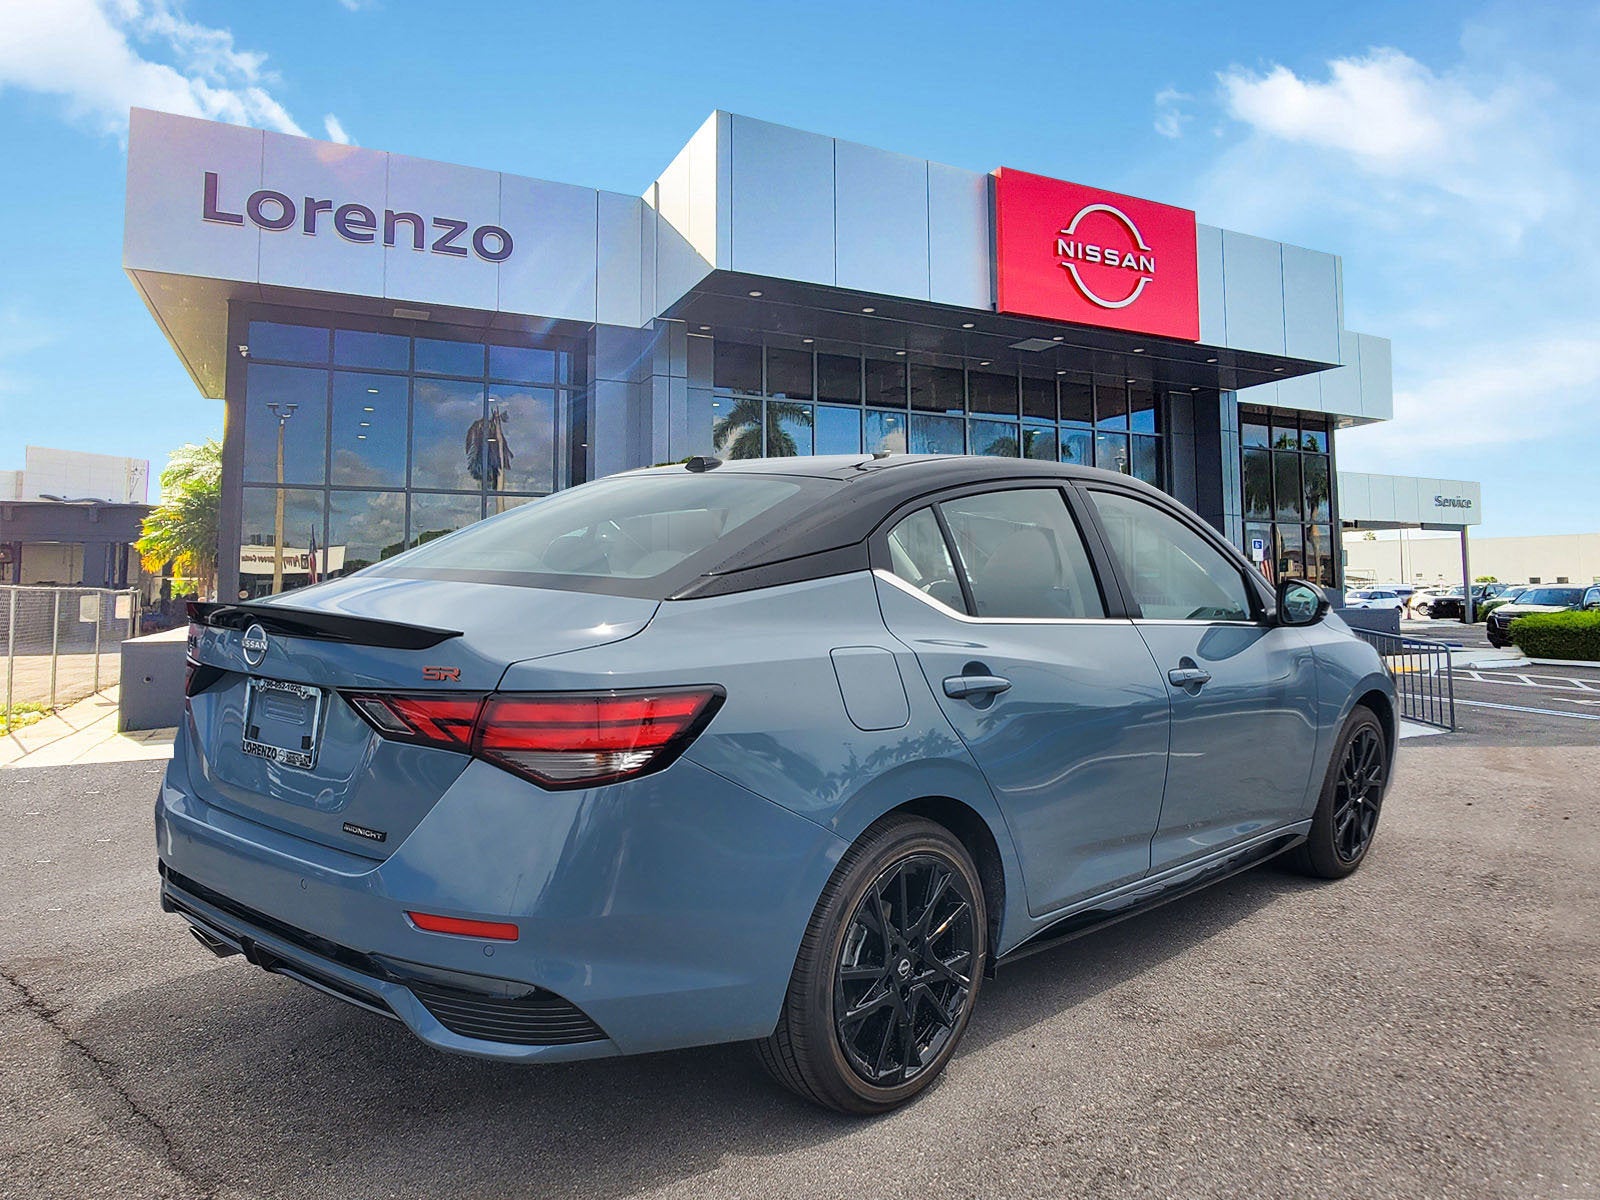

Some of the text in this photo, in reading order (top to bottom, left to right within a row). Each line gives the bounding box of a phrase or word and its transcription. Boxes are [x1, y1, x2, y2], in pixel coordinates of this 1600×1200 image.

[203, 171, 514, 262] Lorenzo
[1057, 238, 1155, 273] NISSAN
[1434, 495, 1472, 508] Service
[422, 665, 461, 682] SR
[242, 741, 278, 760] LORENZO
[343, 823, 383, 839] MIDNIGHT
